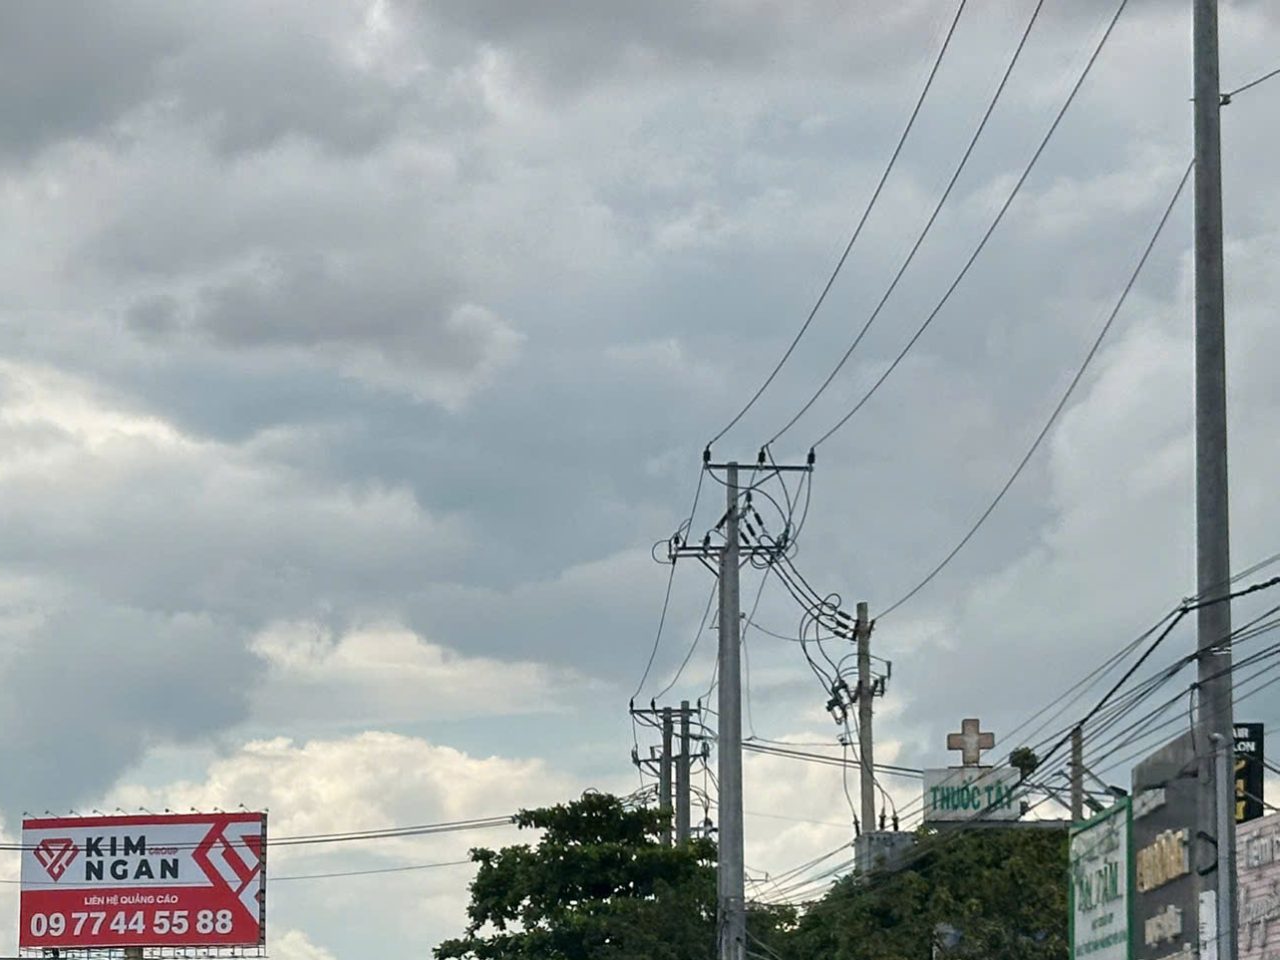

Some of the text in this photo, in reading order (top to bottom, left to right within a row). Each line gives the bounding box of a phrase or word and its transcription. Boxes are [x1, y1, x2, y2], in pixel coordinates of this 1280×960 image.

[931, 776, 981, 811] THUỐC
[86, 836, 146, 857] KIM
[85, 858, 179, 881] NGAN
[84, 893, 105, 906] LIÊN
[120, 892, 155, 905] QUẢNG
[156, 893, 179, 904] CÁO
[30, 912, 66, 937] 09
